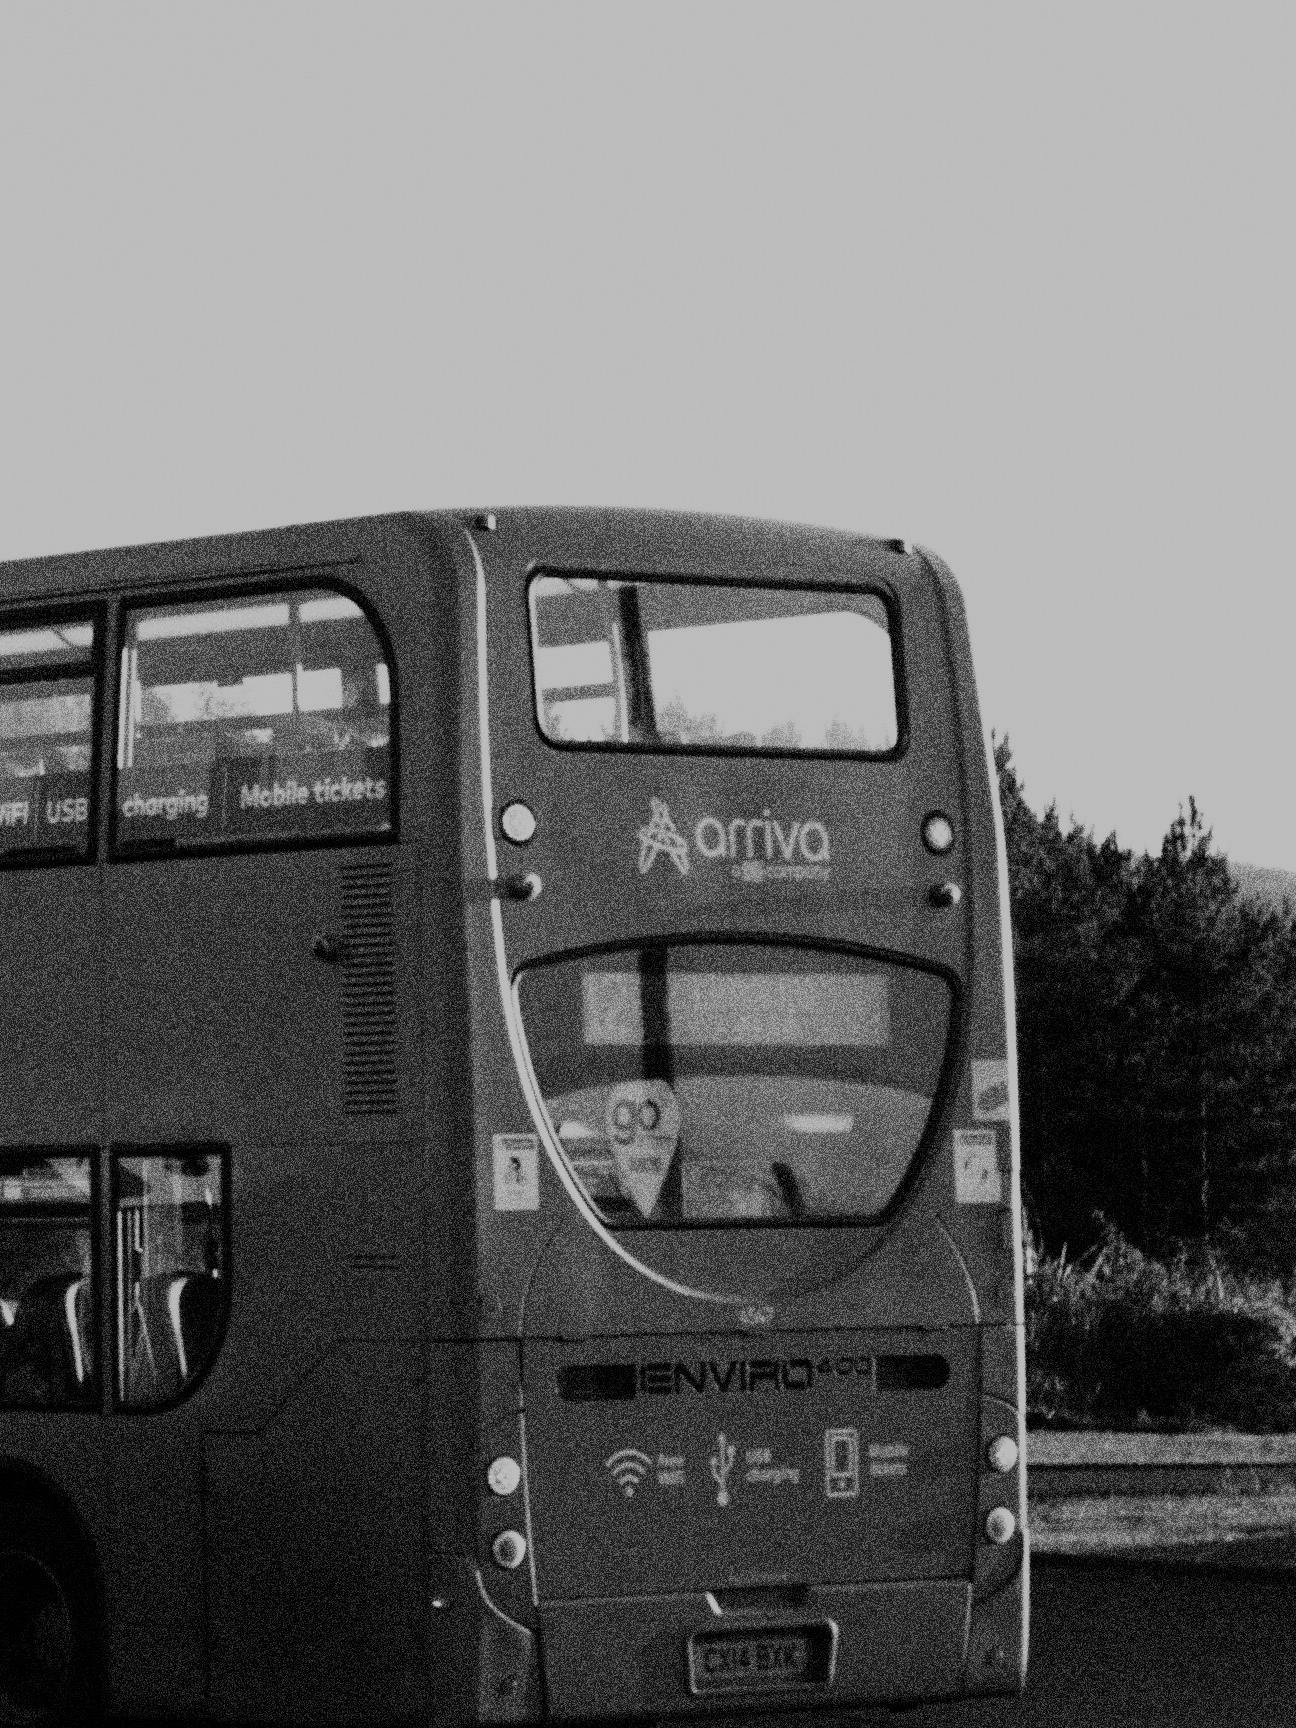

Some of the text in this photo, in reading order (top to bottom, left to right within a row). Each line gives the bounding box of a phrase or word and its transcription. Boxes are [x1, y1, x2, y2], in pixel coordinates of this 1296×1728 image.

[47, 798, 89, 825] USB
[122, 790, 209, 820] charging
[239, 781, 309, 810] Mobile
[313, 777, 387, 804] tickets
[695, 808, 830, 862] arriva
